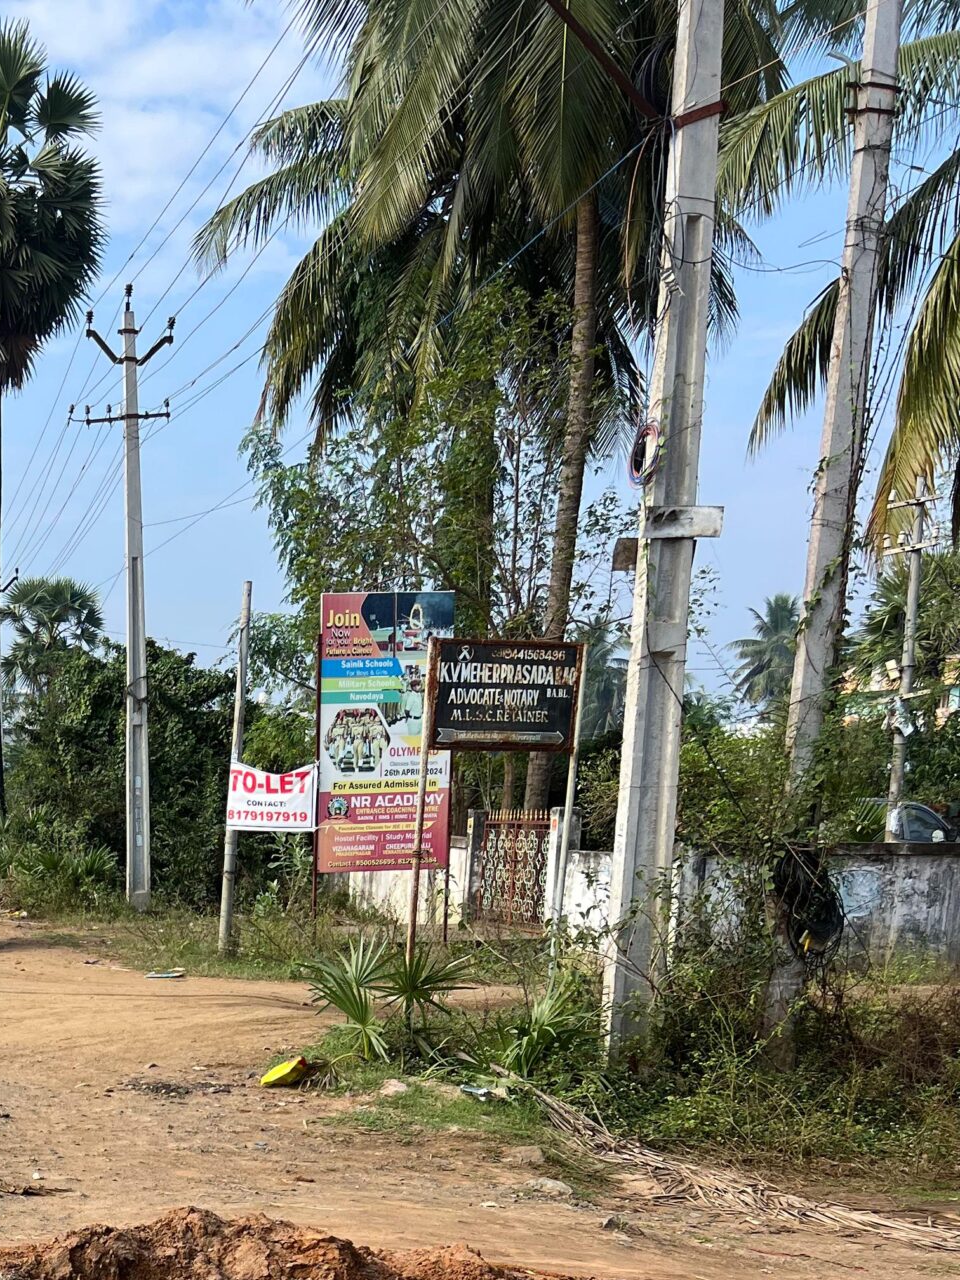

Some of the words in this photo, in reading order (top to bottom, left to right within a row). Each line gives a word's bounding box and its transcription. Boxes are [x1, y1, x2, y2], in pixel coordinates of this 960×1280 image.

[326, 609, 360, 628] Join
[353, 637, 372, 647] Bright
[326, 648, 346, 656] Future
[352, 647, 373, 656] Career
[365, 660, 394, 668] Schools
[350, 692, 384, 701] Navodaya
[448, 688, 500, 705] ADVOCATE
[504, 688, 540, 706] NOTARY
[230, 769, 311, 794] TO-LET
[333, 782, 346, 790] For
[348, 780, 382, 790] Assured
[351, 796, 371, 808] NR
[228, 809, 308, 822] 8179197919
[334, 834, 354, 842] Hostel
[356, 834, 379, 844] Facility
[386, 832, 404, 842] Study
